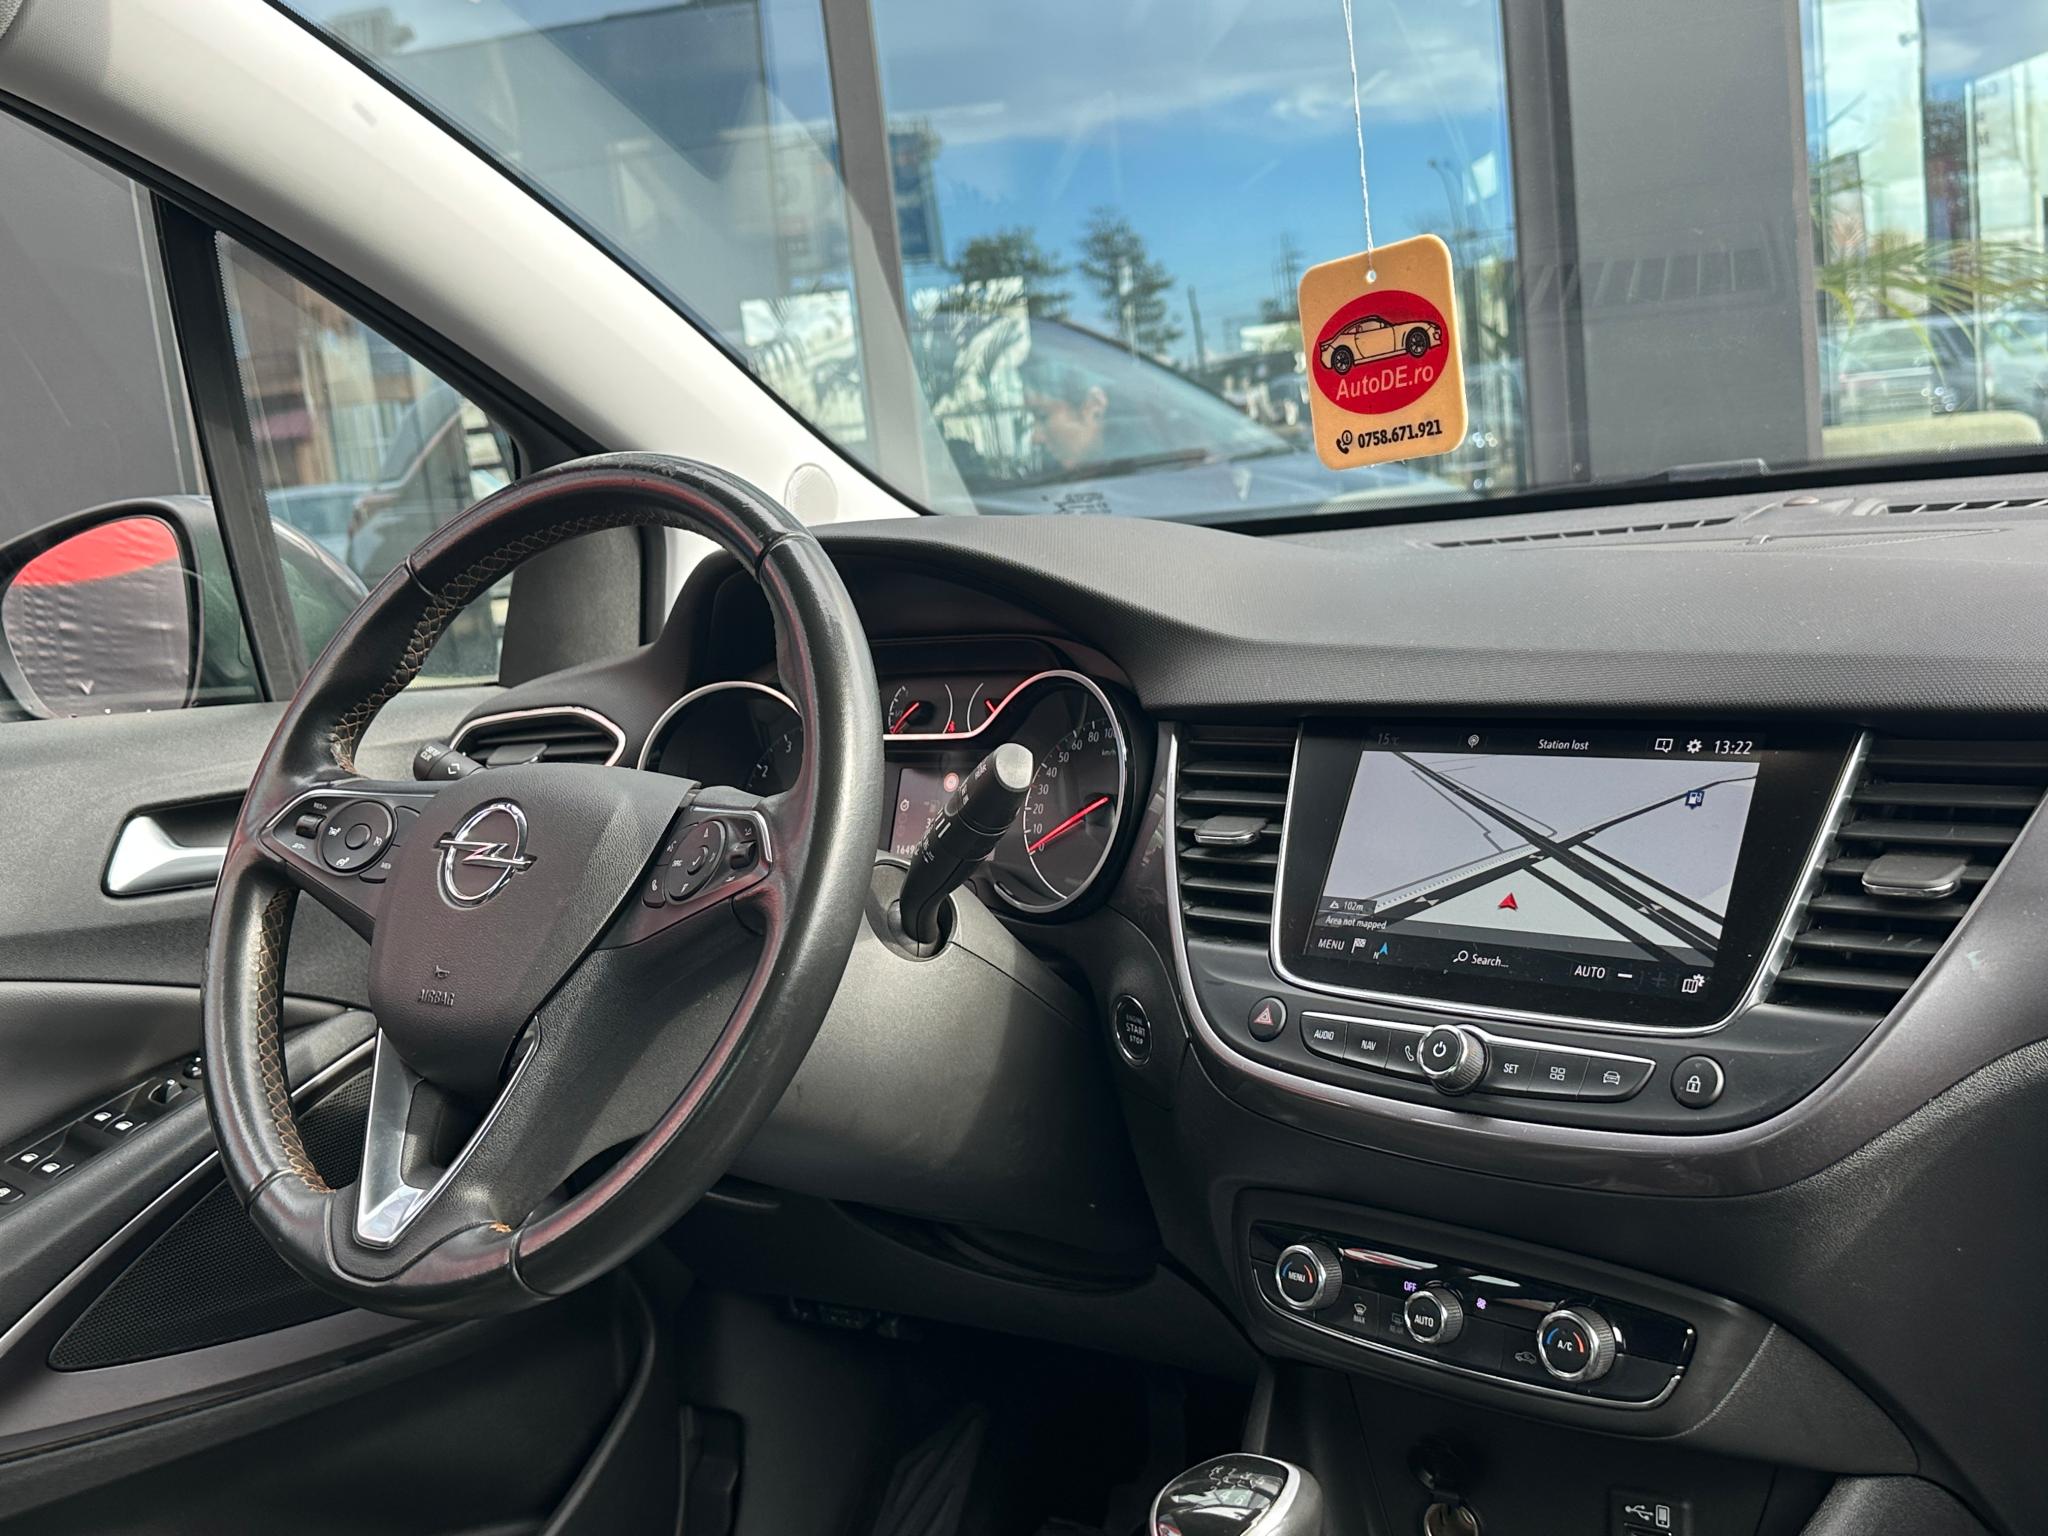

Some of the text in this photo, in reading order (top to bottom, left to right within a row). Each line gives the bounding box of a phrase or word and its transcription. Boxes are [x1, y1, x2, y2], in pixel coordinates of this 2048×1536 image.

[1335, 364, 1434, 401] AutoDE.ro
[1357, 419, 1443, 449] 0758.671.921
[1087, 731, 1100, 743] 80
[1071, 739, 1083, 751] 60
[1537, 738, 1590, 751] Station lost
[1713, 740, 1753, 755] 13:22
[1058, 751, 1070, 763] 50
[1046, 766, 1058, 778] 40
[1037, 784, 1049, 795] 30
[1032, 803, 1044, 815] 20
[1032, 823, 1043, 835] 10
[1343, 901, 1364, 912] 102m
[1325, 915, 1388, 932] Area not mapped
[1318, 938, 1345, 951] MENU
[1574, 964, 1606, 979] AUTO
[1125, 1022, 1146, 1038] START
[1313, 1029, 1335, 1041] AUDIO
[1360, 1039, 1377, 1051] NAV
[1503, 1062, 1520, 1075] SET
[1287, 1271, 1306, 1283] MENU
[1403, 1280, 1417, 1292] OFF
[1414, 1314, 1434, 1328] AUTO
[1557, 1339, 1573, 1351] A/C
